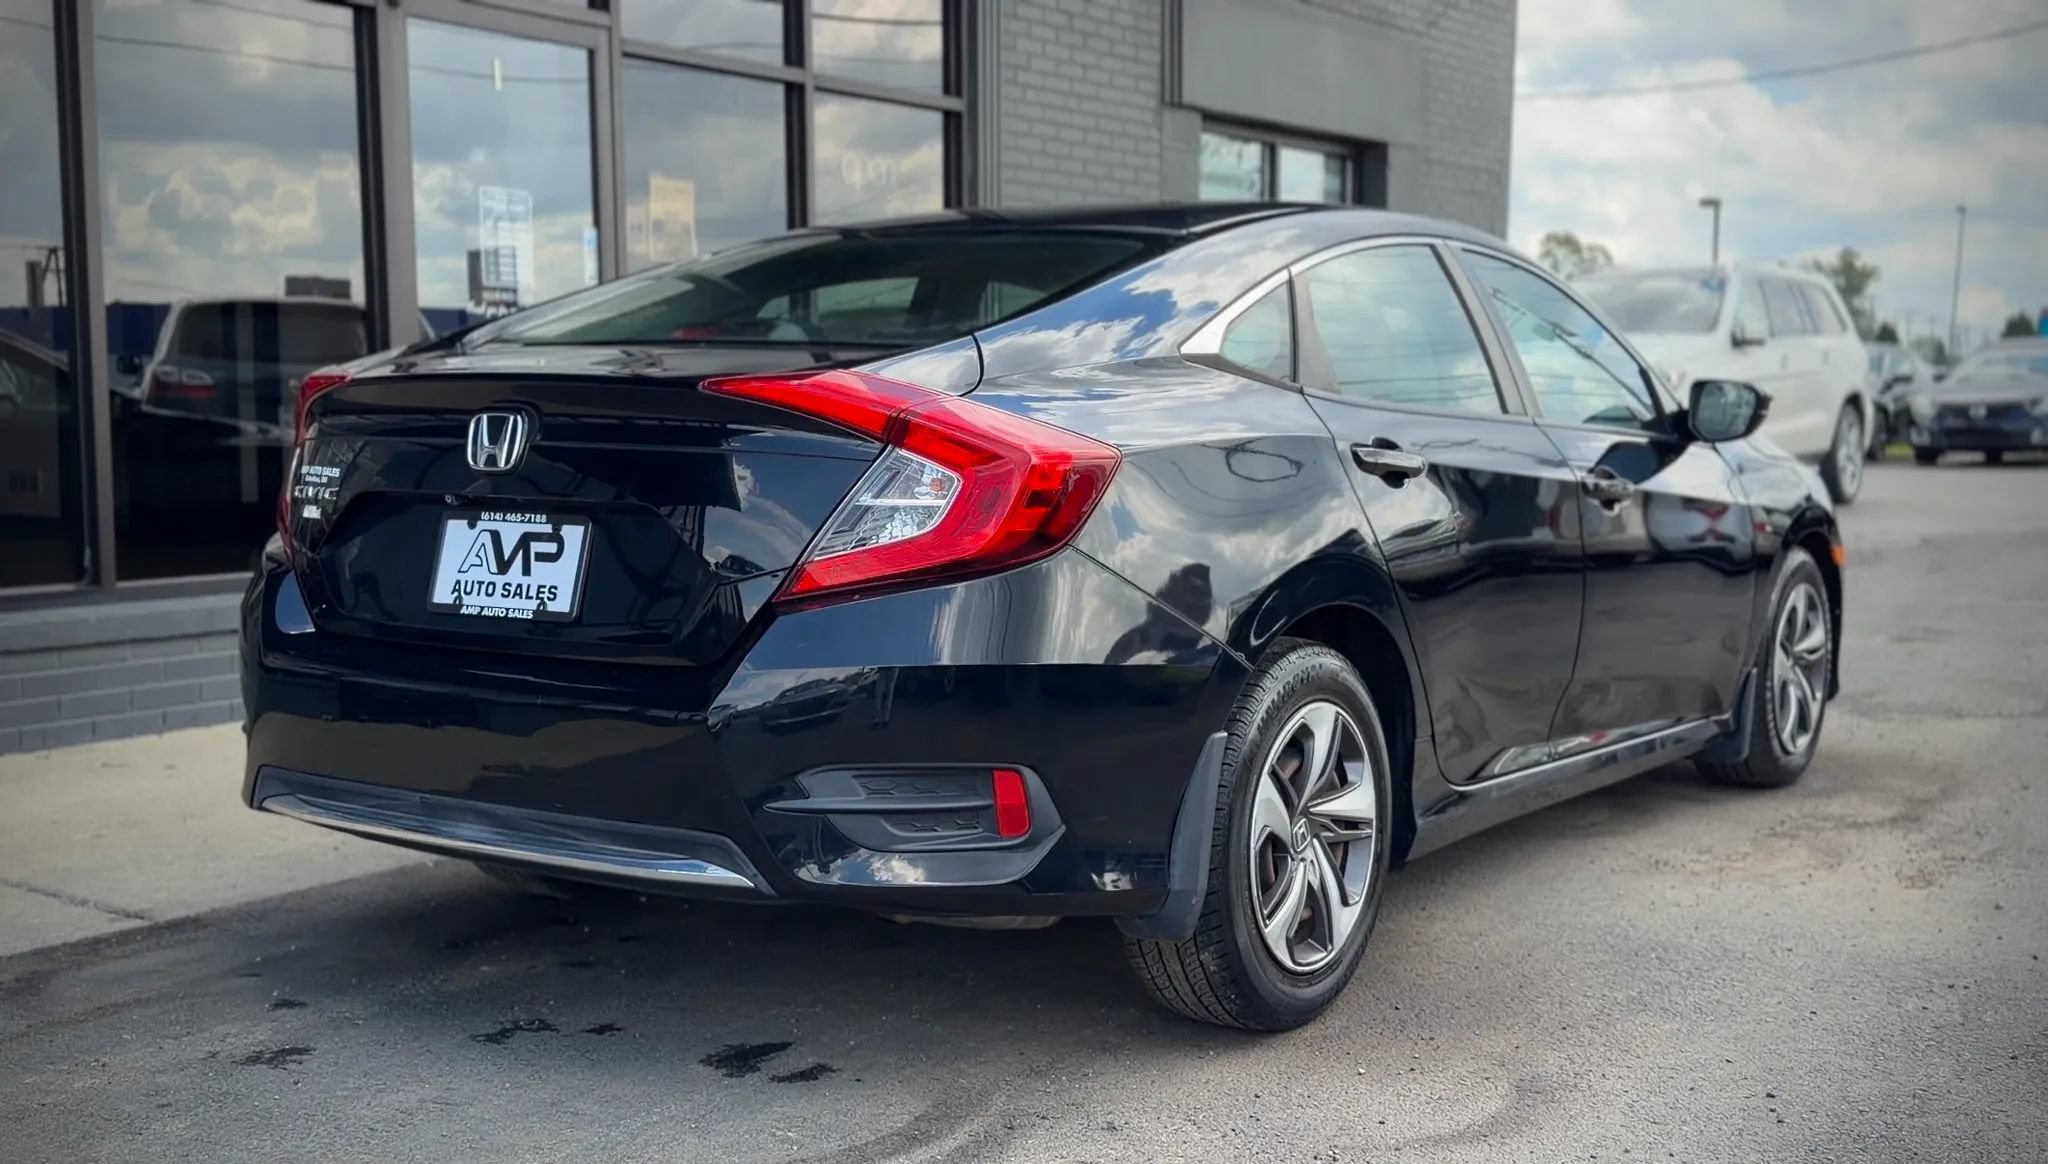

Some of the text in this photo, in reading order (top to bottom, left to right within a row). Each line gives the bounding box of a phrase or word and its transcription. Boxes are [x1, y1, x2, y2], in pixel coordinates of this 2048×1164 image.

[322, 466, 341, 477] SALES
[295, 486, 339, 500] CIVIC
[481, 512, 547, 523] (614) 465-7188
[458, 529, 565, 576] AMP
[451, 579, 559, 602] AUTO SALES
[460, 605, 534, 619] AMP AUTO SALES
